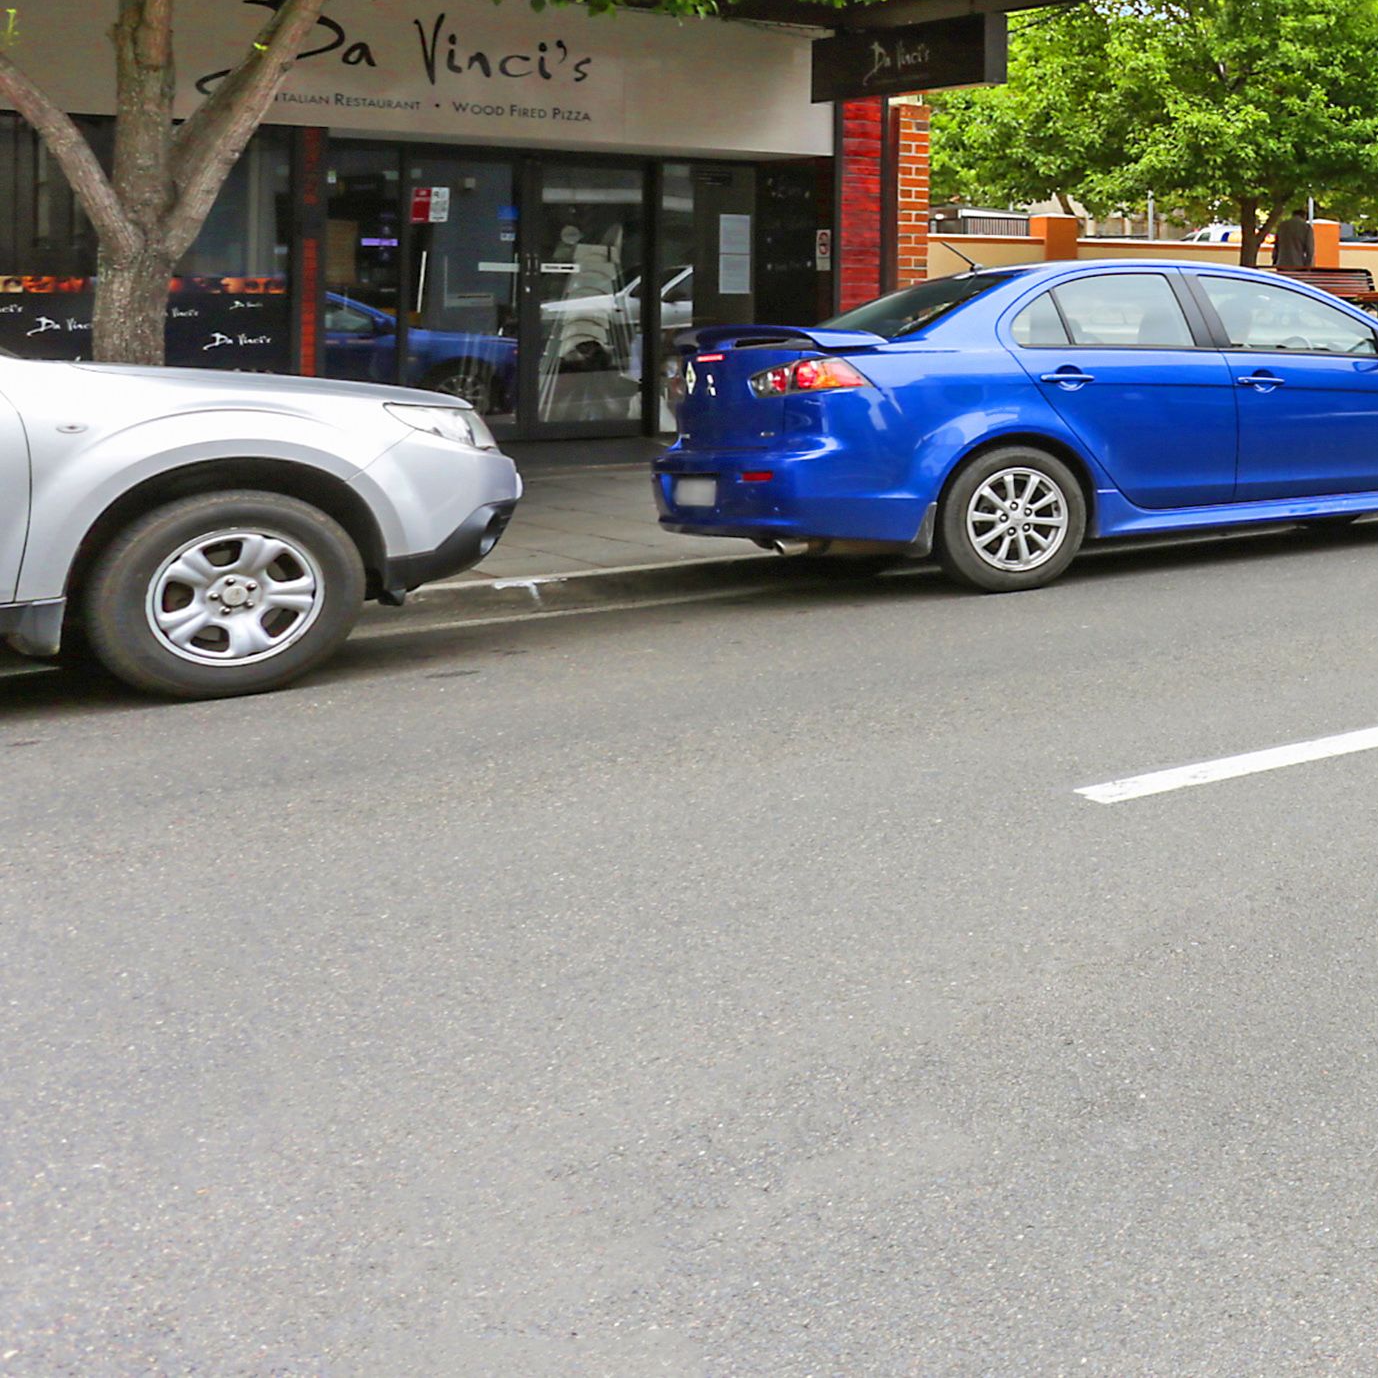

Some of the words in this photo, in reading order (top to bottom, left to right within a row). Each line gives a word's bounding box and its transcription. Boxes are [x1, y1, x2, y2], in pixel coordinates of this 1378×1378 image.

[414, 13, 591, 85] Vinci's
[452, 100, 505, 117] WOOD
[510, 104, 547, 120] FIRED
[552, 107, 592, 122] PIZZA
